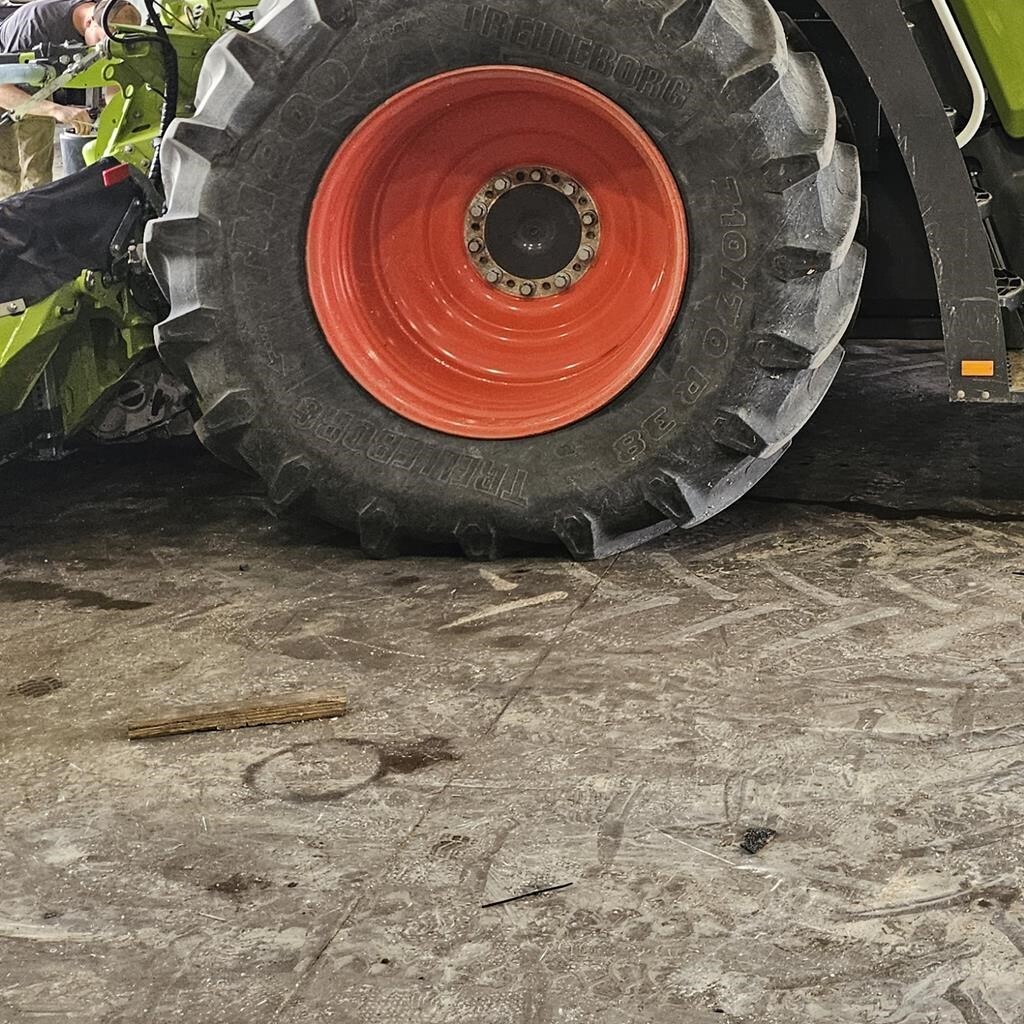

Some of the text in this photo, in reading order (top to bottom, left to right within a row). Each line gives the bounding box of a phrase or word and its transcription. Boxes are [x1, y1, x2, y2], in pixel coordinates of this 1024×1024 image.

[460, 4, 694, 108] TRELLEBORG
[668, 362, 715, 410] R
[286, 392, 531, 507] TRELLEBORG
[607, 402, 682, 467] 38
